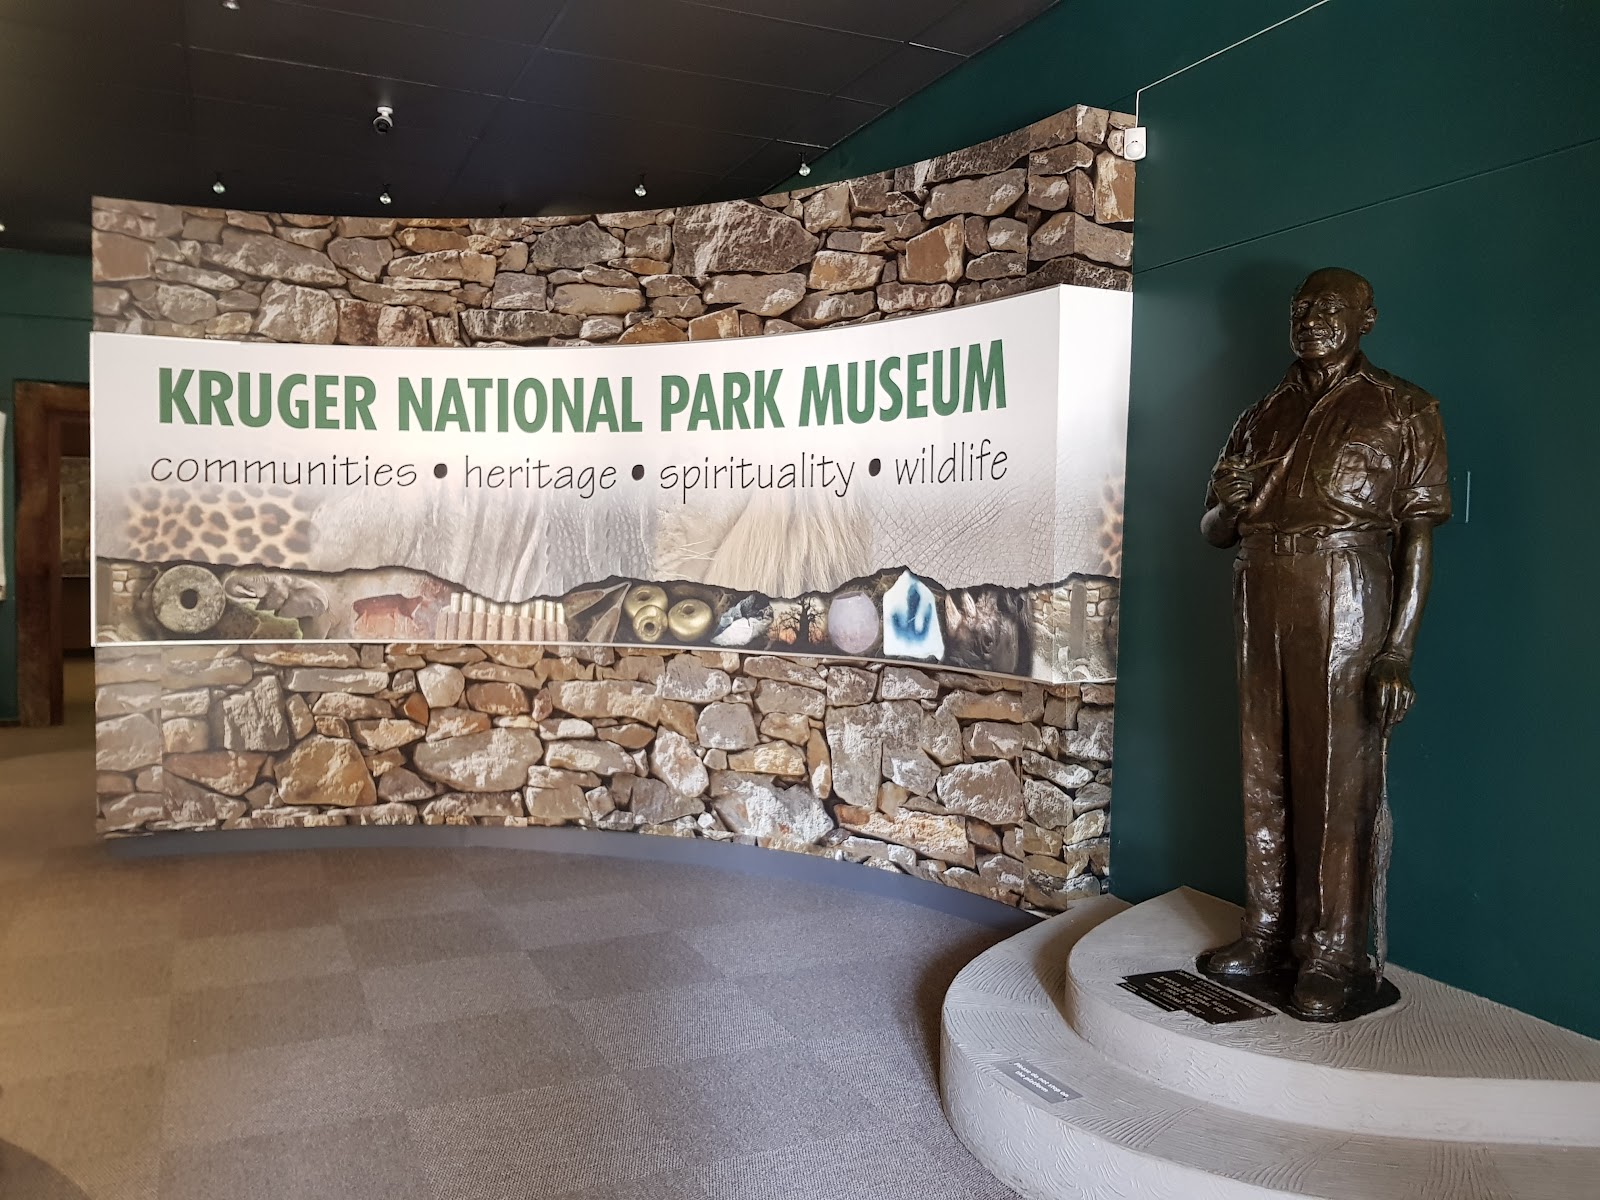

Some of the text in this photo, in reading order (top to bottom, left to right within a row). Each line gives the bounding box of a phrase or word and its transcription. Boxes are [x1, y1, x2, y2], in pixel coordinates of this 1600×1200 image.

[159, 339, 1007, 433] KRUGER NATIONAL PARK MUSEUM
[150, 438, 1008, 504] communities heritage spirituality wildlife
[1014, 1062, 1031, 1073] Please
